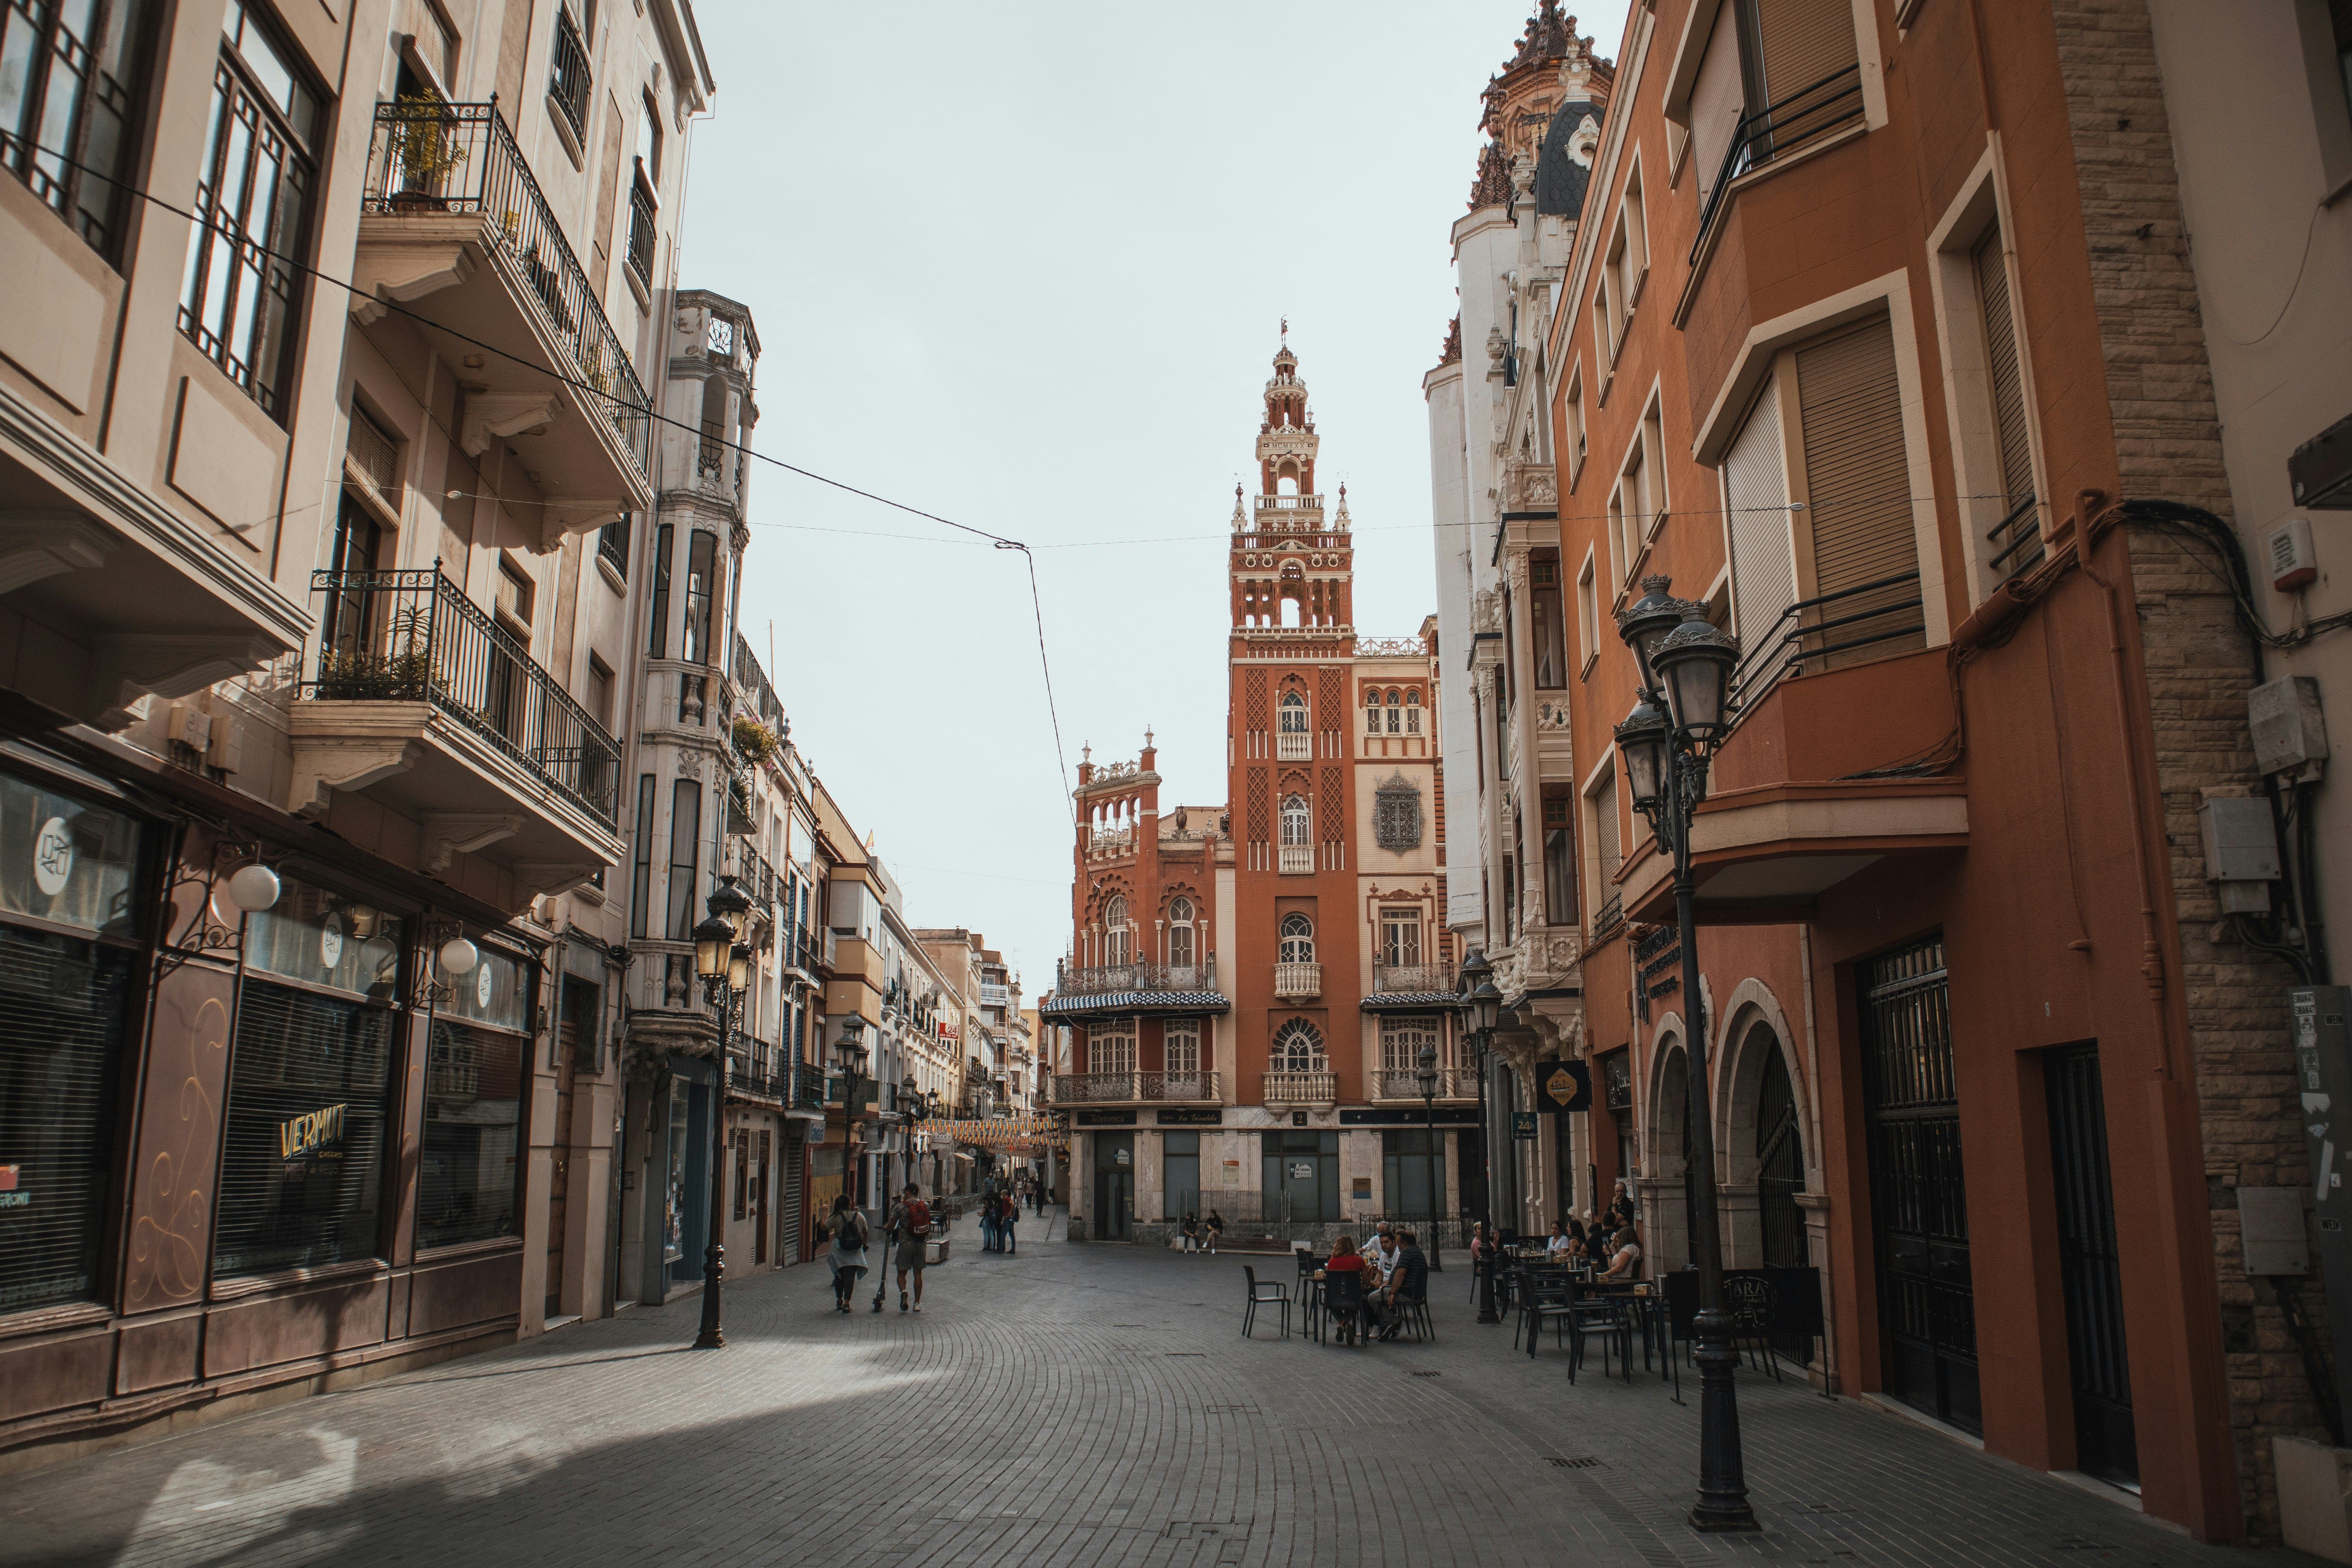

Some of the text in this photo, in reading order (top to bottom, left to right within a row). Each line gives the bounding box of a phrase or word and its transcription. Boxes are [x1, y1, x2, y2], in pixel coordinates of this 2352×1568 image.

[1090, 1114, 1124, 1122] Telefónica
[1297, 1114, 1303, 1124] 2
[1518, 1121, 1535, 1130] 24h
[281, 1103, 347, 1160] VERMUT
